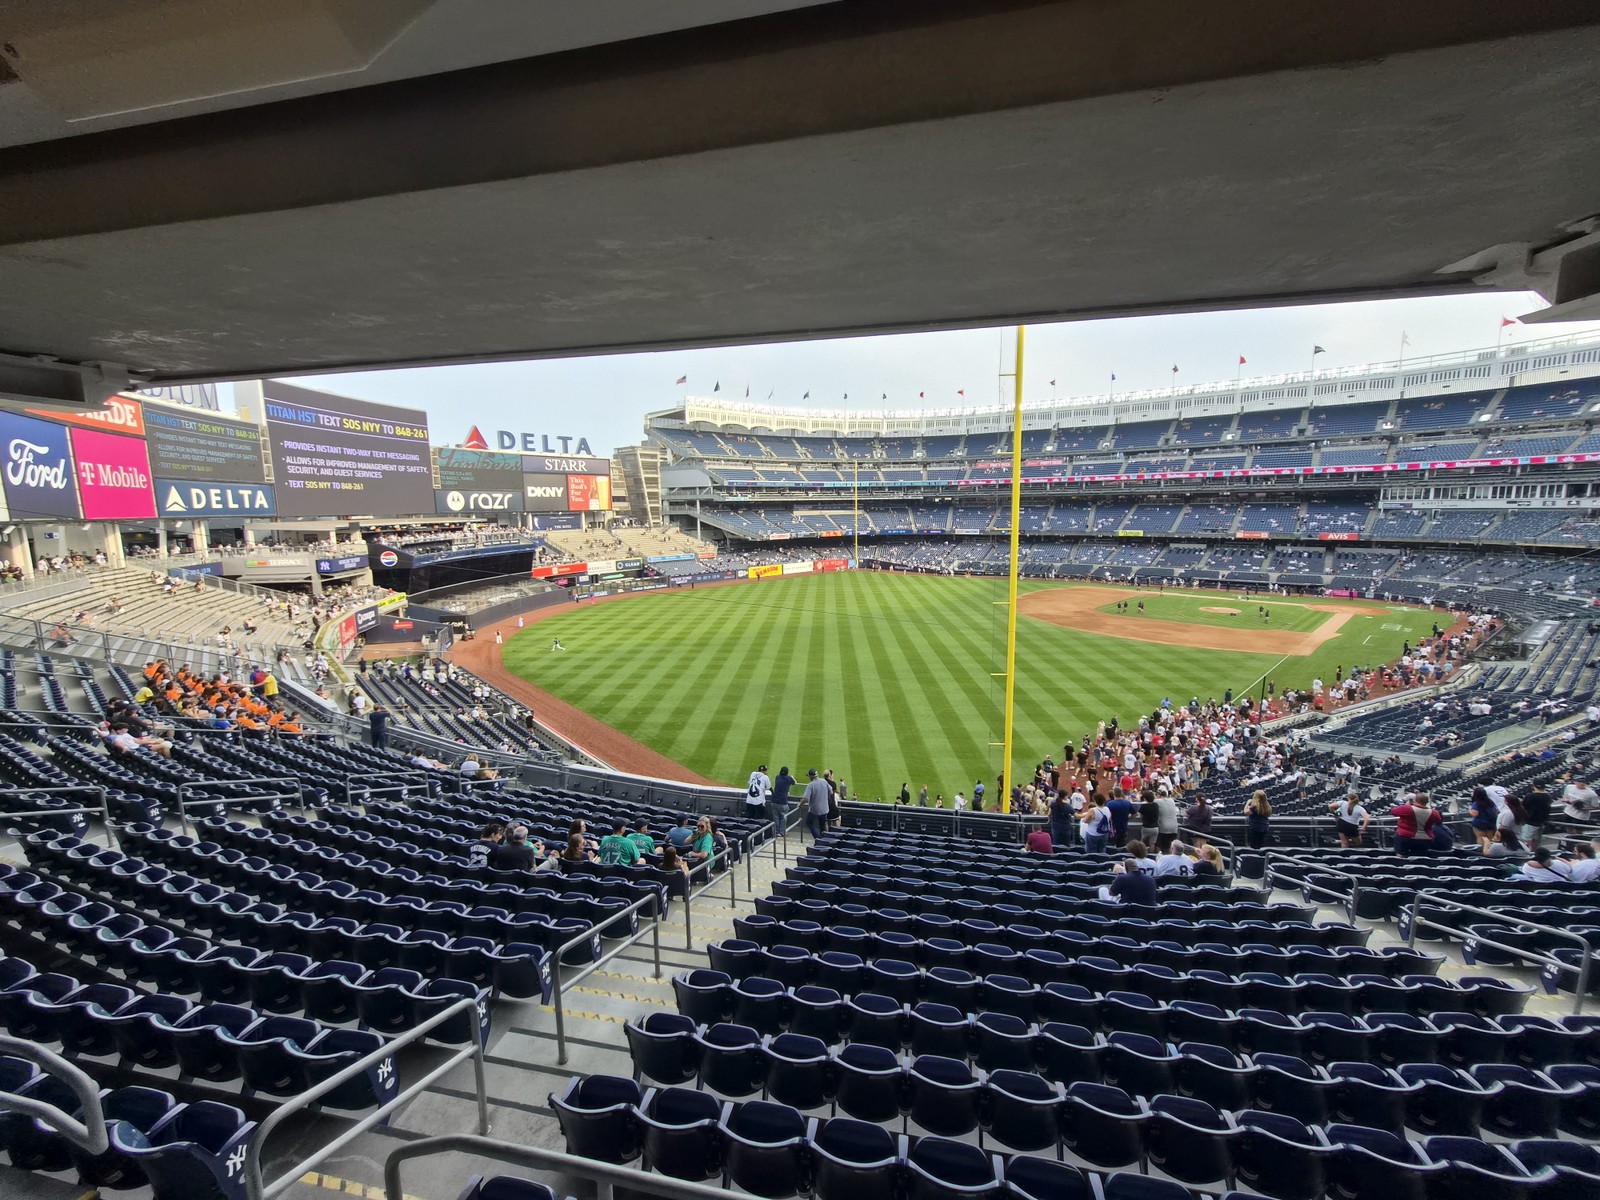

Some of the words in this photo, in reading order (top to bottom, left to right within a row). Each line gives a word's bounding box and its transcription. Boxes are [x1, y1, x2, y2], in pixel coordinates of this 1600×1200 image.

[147, 412, 166, 424] TITAN
[181, 420, 198, 431] TEXT
[198, 423, 211, 433] SOS
[212, 426, 225, 435] NYY
[226, 427, 235, 437] TO
[267, 403, 296, 421] TITAN
[298, 410, 317, 424] HST
[318, 413, 342, 428] TEXT
[343, 418, 361, 431] SOS
[362, 421, 380, 434] NYY
[382, 423, 394, 435] TO
[395, 426, 428, 439] 848-261
[284, 441, 316, 452] PROVIDES
[316, 444, 342, 454] INSTANT
[343, 447, 371, 457] TWO-WAY
[372, 450, 386, 459] TEXT
[387, 452, 420, 461] MESSAGING
[497, 430, 594, 456] DELTA
[7, 438, 68, 490] Ford
[286, 456, 312, 466] ALLOWS
[312, 458, 325, 467] FOR
[325, 459, 357, 469] IMPROVED
[357, 461, 397, 472] MANAGEMENT
[398, 464, 406, 472] OF
[406, 465, 429, 474] SAFETY,
[287, 465, 320, 476] SECURITY,
[321, 467, 333, 476] AND
[334, 469, 354, 478] GUEST
[354, 470, 383, 479] SERVICES
[545, 458, 588, 472] STARR
[97, 463, 148, 489] Mobile
[289, 479, 304, 488] TEXT
[304, 480, 318, 489] SOS
[318, 481, 331, 490] NYY
[332, 481, 341, 490] TO
[190, 487, 270, 510] DELTA
[527, 486, 564, 498] DKNY
[470, 493, 513, 510] razr
[602, 851, 622, 865] 47
[1178, 865, 1189, 878] 8
